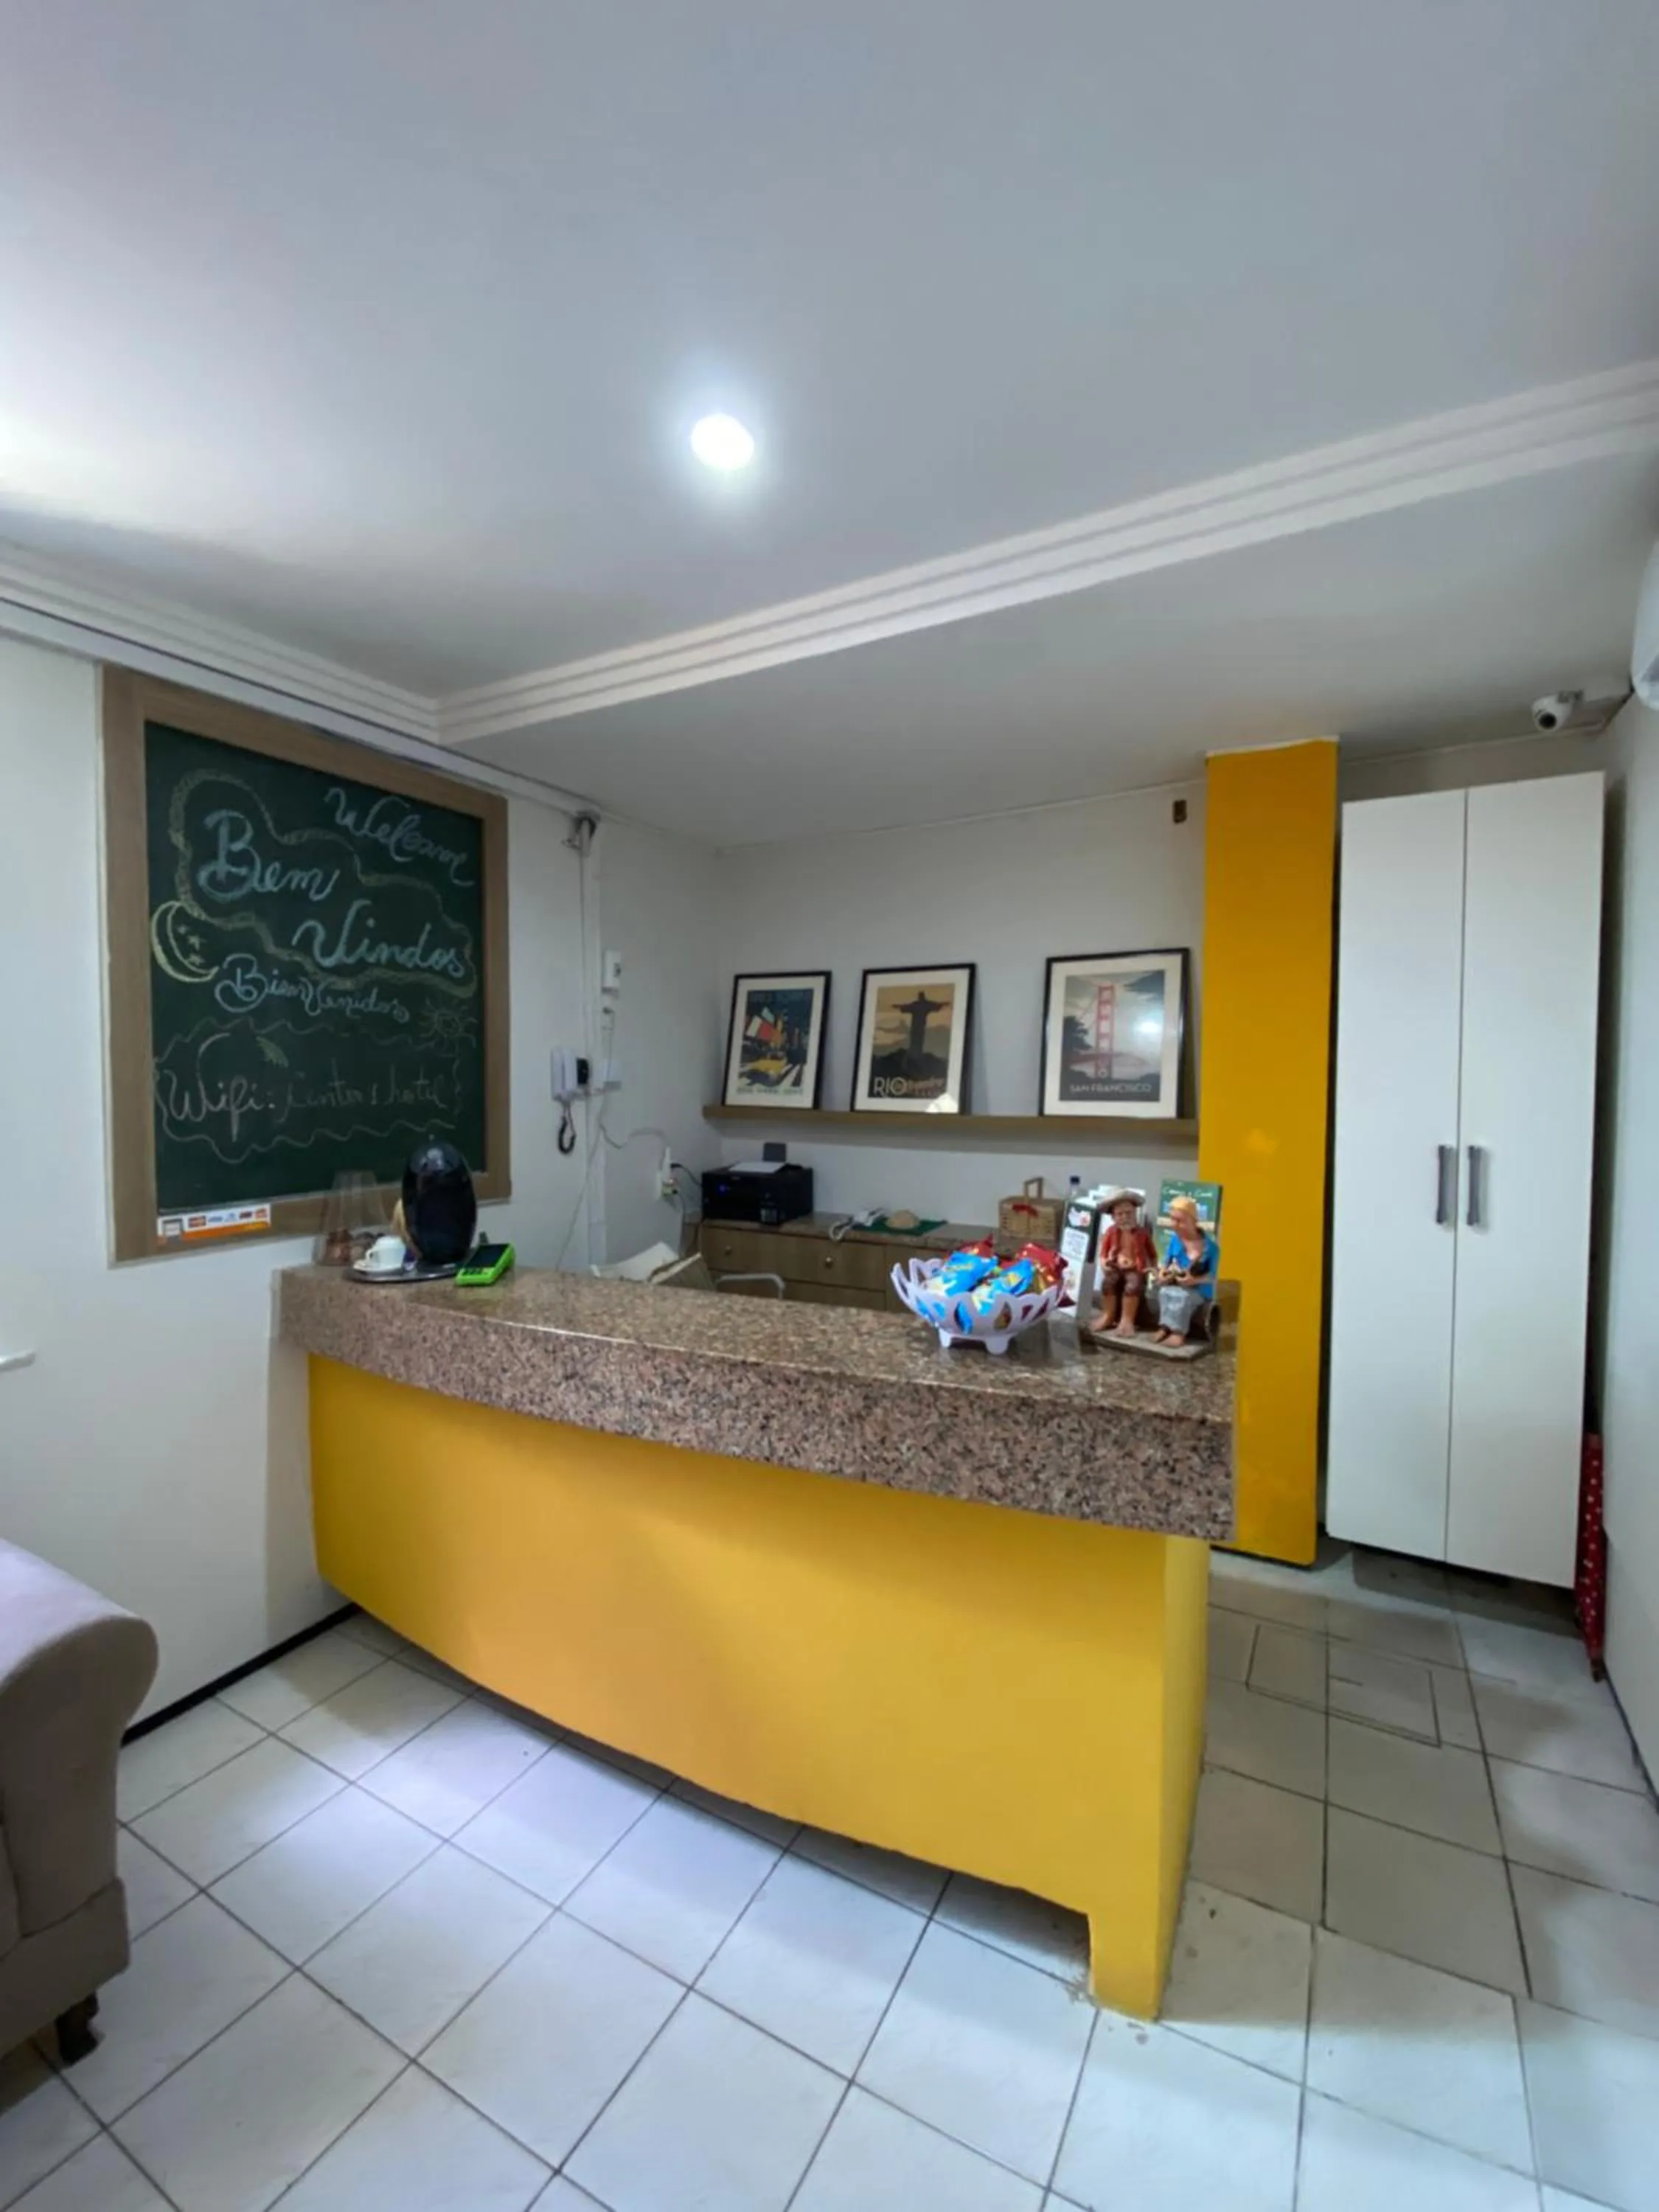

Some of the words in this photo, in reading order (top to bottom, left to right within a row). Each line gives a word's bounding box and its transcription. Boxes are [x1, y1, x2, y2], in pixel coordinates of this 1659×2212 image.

[196, 809, 340, 903] Bem
[292, 899, 465, 978] Vindos
[873, 1076, 907, 1098] RIO
